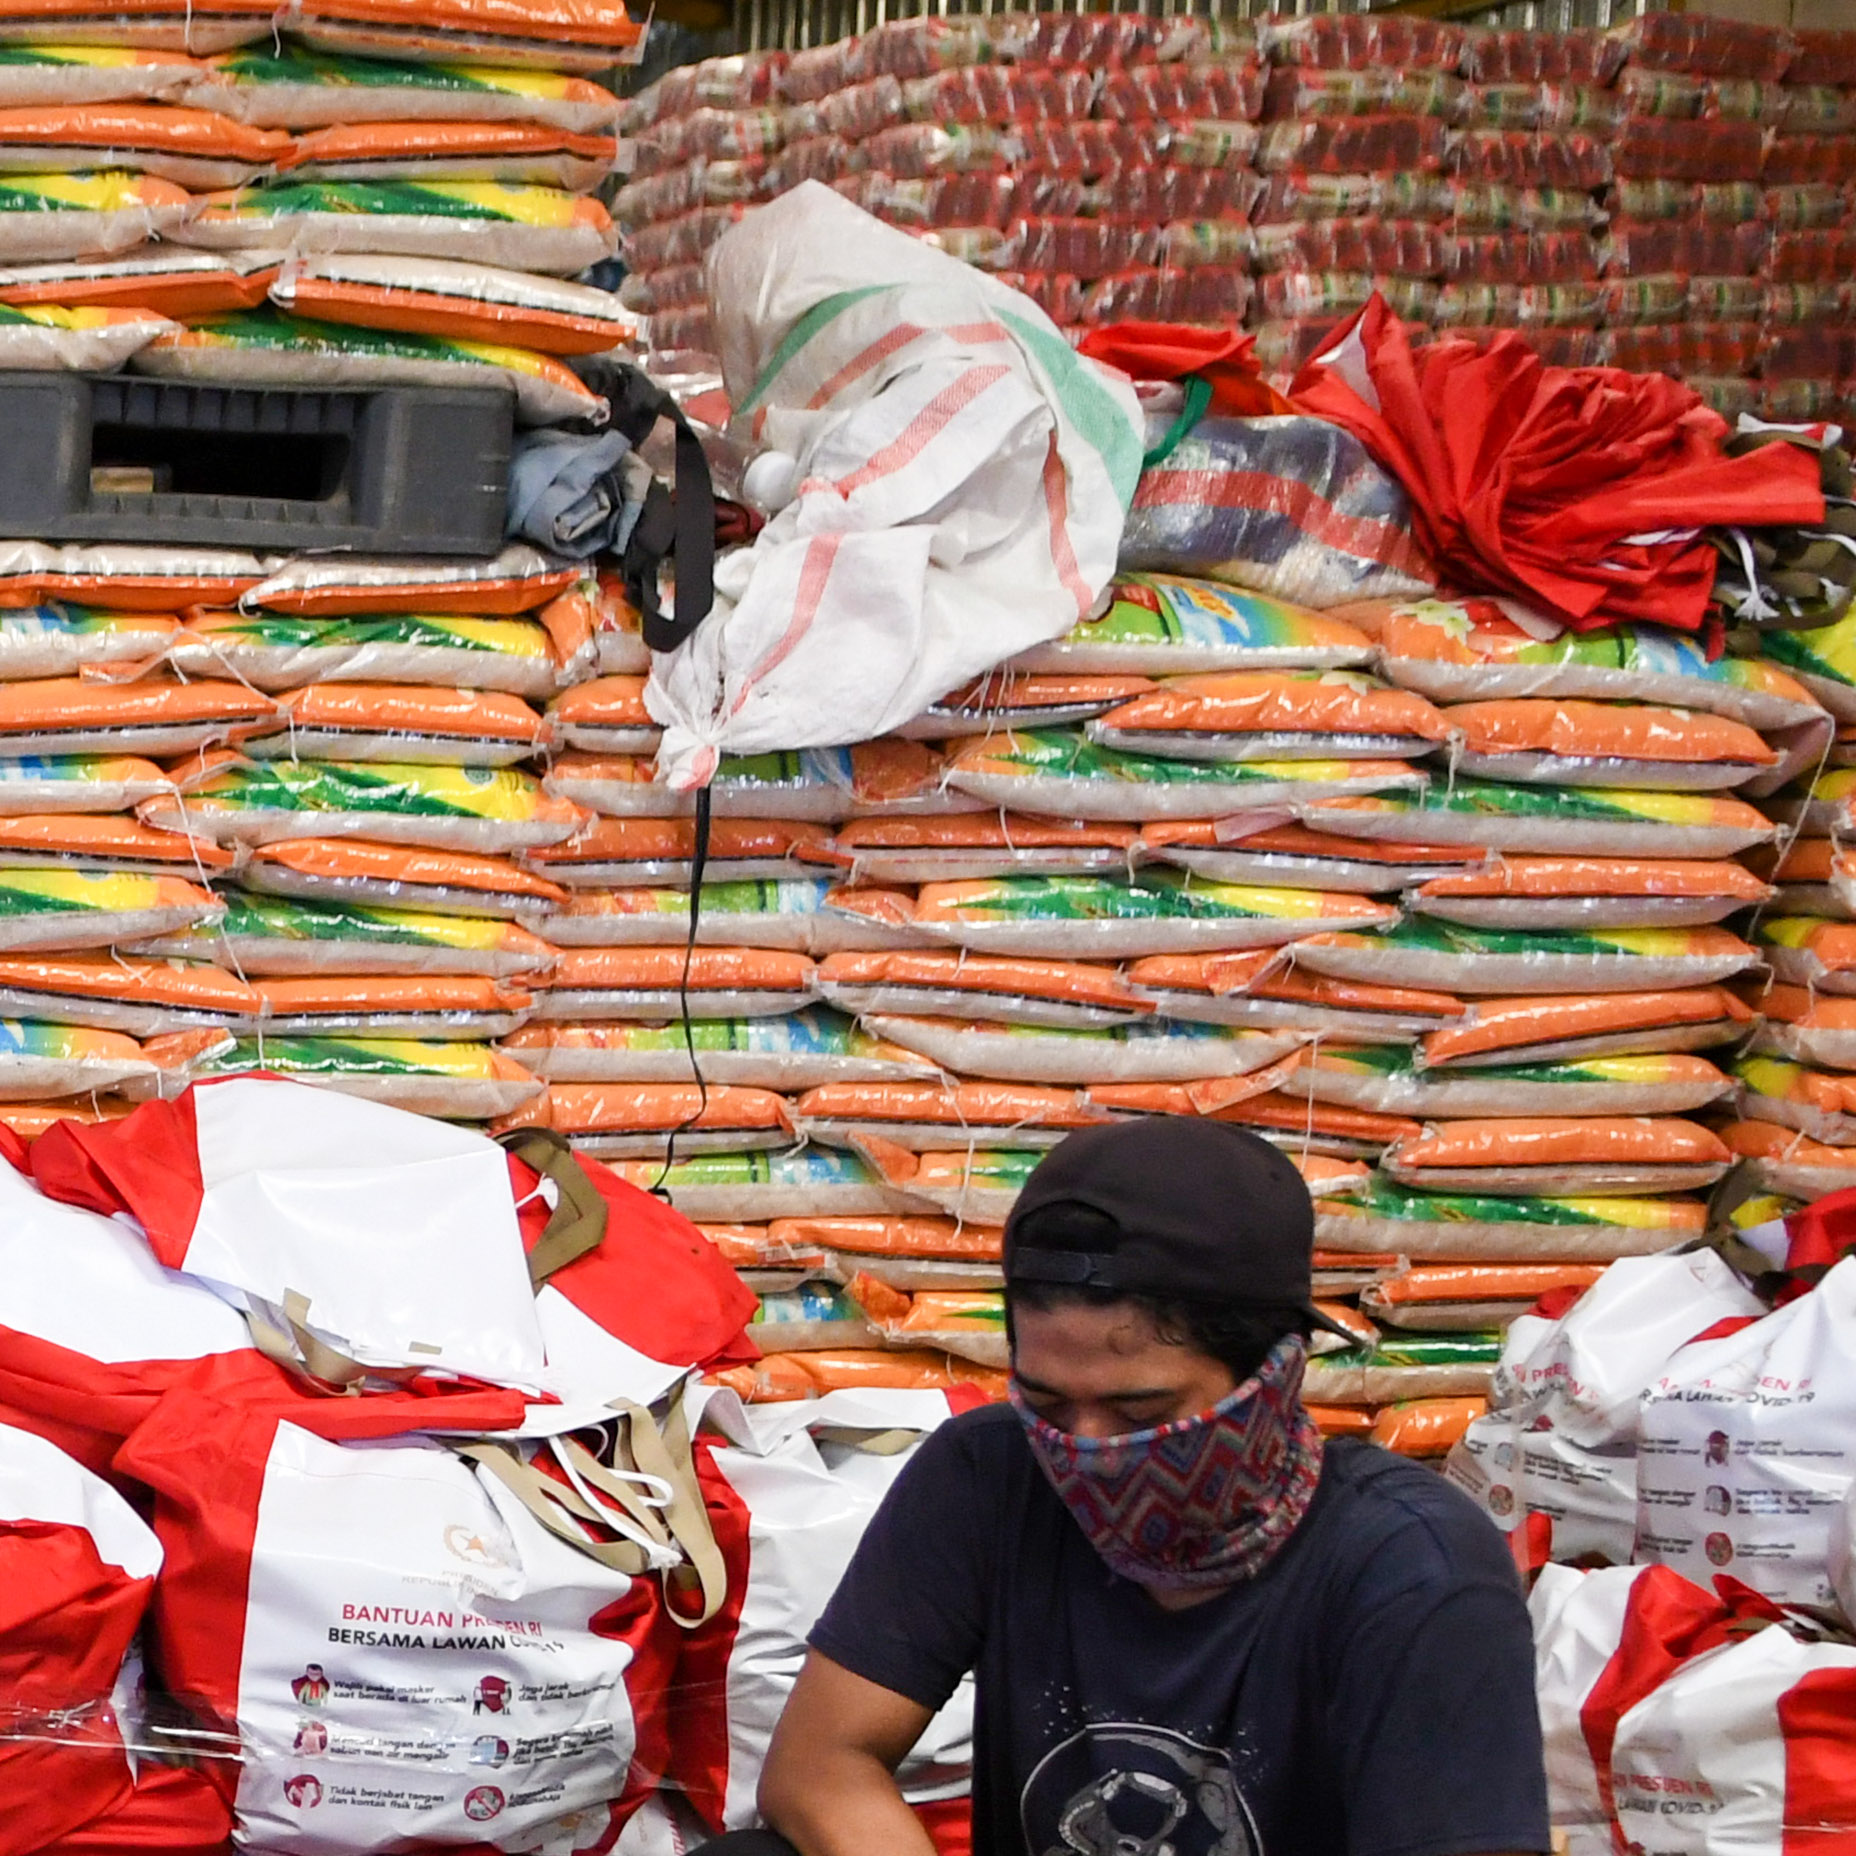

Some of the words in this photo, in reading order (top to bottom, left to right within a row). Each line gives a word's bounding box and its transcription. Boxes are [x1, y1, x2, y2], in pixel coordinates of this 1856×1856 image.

[342, 1603, 453, 1628] BANTUAN
[528, 1619, 543, 1638] RI
[328, 1627, 426, 1650] BERSAMA
[431, 1634, 506, 1651] LAWAN
[396, 1684, 436, 1695] masker
[330, 1786, 357, 1798] Tidak
[360, 1787, 406, 1801] berjabat
[407, 1792, 446, 1804] tangan
[413, 1800, 434, 1812] lain
